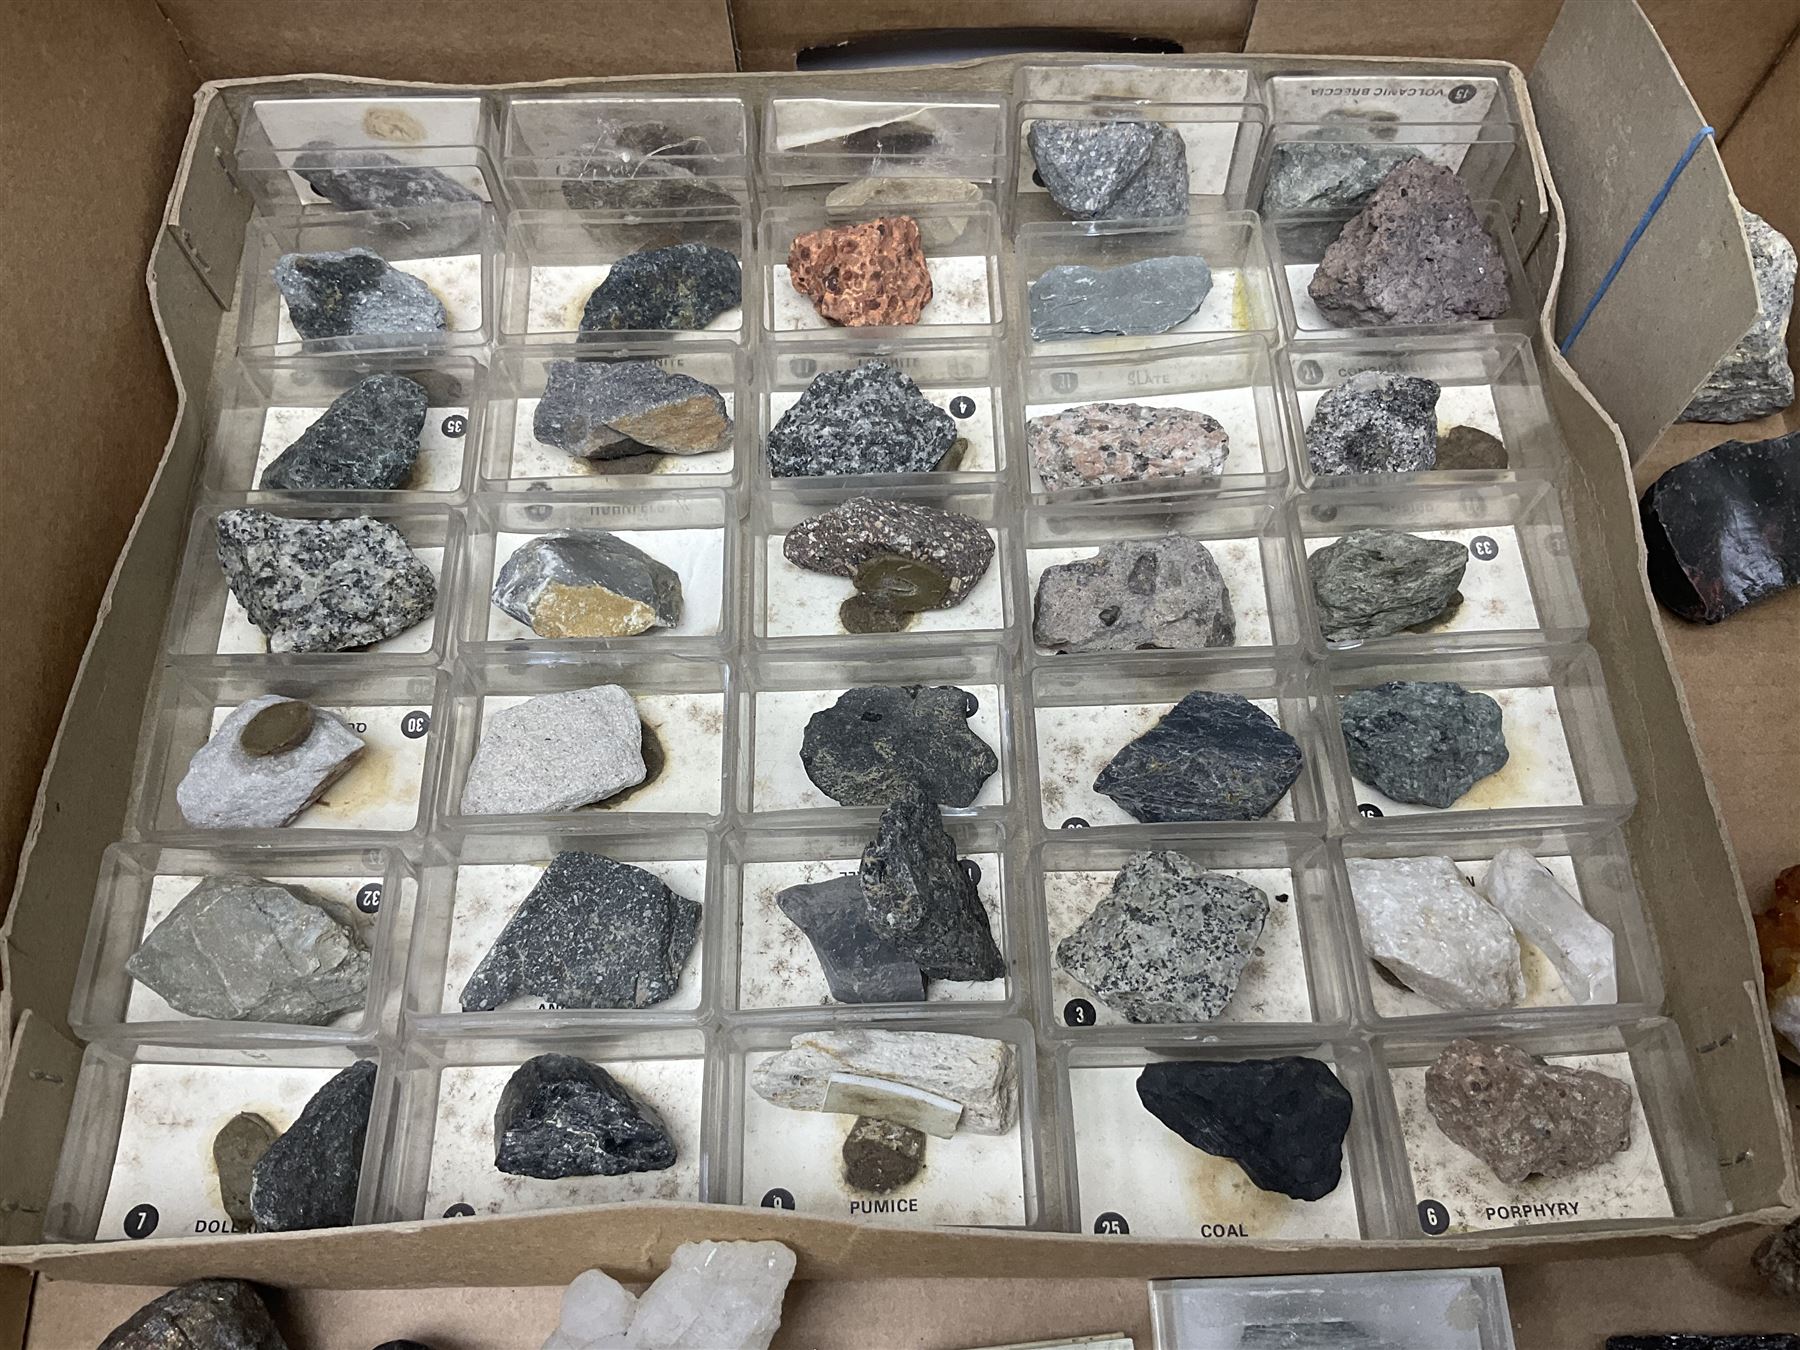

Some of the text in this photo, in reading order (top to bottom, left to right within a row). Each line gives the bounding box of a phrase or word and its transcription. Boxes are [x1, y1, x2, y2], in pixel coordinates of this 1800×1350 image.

[1311, 86, 1370, 96] BRECCIA
[1373, 87, 1444, 97] VOLCANIC
[447, 420, 463, 433] 35
[1475, 541, 1493, 555] 33
[407, 717, 424, 733] 30
[363, 890, 381, 906] 32
[1075, 1006, 1085, 1023] 3
[849, 1198, 919, 1215] PUMICE
[1426, 1201, 1580, 1226] 6 PORPHYRY
[136, 1212, 147, 1231] 7
[1200, 1223, 1249, 1238] COAL
